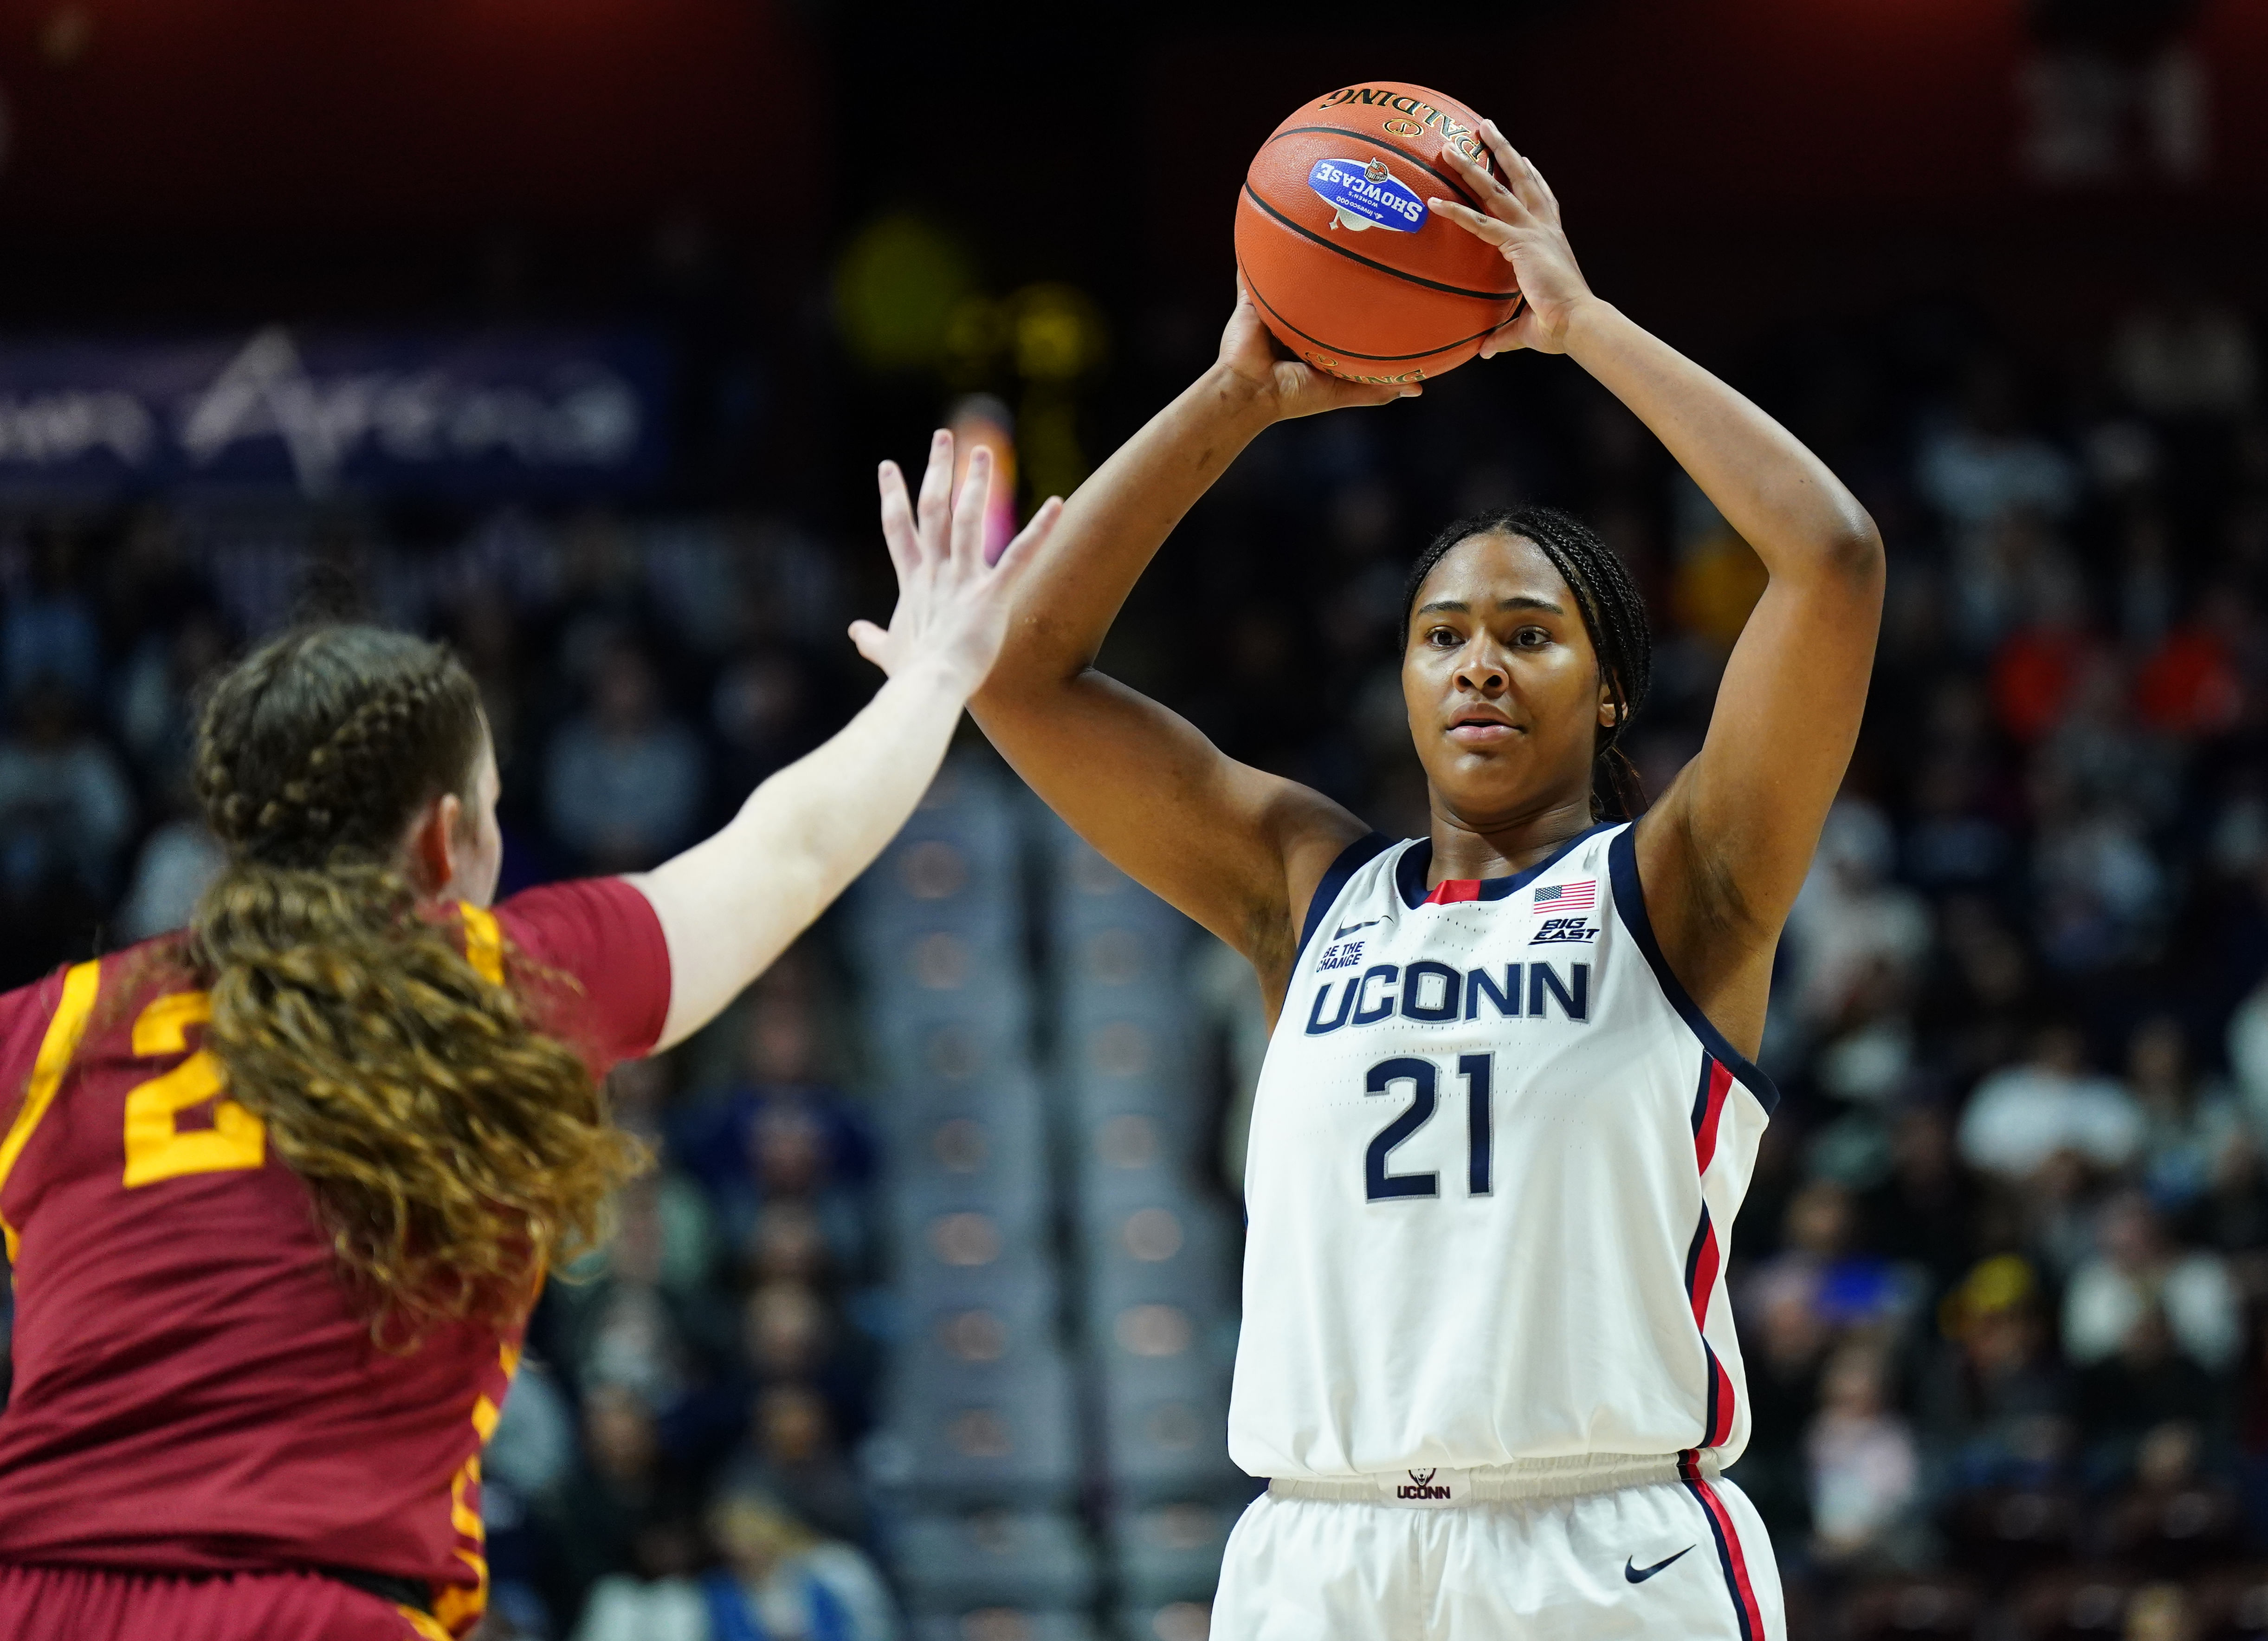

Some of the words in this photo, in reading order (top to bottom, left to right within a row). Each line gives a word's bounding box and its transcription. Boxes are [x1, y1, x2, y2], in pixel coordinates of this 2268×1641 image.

[1318, 89, 1494, 177] PALDING
[1316, 163, 1423, 222] SHOWCASE
[1336, 195, 1350, 206] QQQ
[1348, 191, 1378, 208] WOMEN'S
[1350, 202, 1373, 217] Invesco
[1541, 917, 1588, 930] BIG
[1533, 929, 1600, 940] EAST
[1323, 945, 1339, 958] BE
[1341, 941, 1365, 956] THE
[1316, 953, 1362, 973] CHANGE
[1304, 959, 1590, 1038] UCONN
[1363, 1051, 1496, 1204] 21
[1397, 1485, 1451, 1499] UCONN
